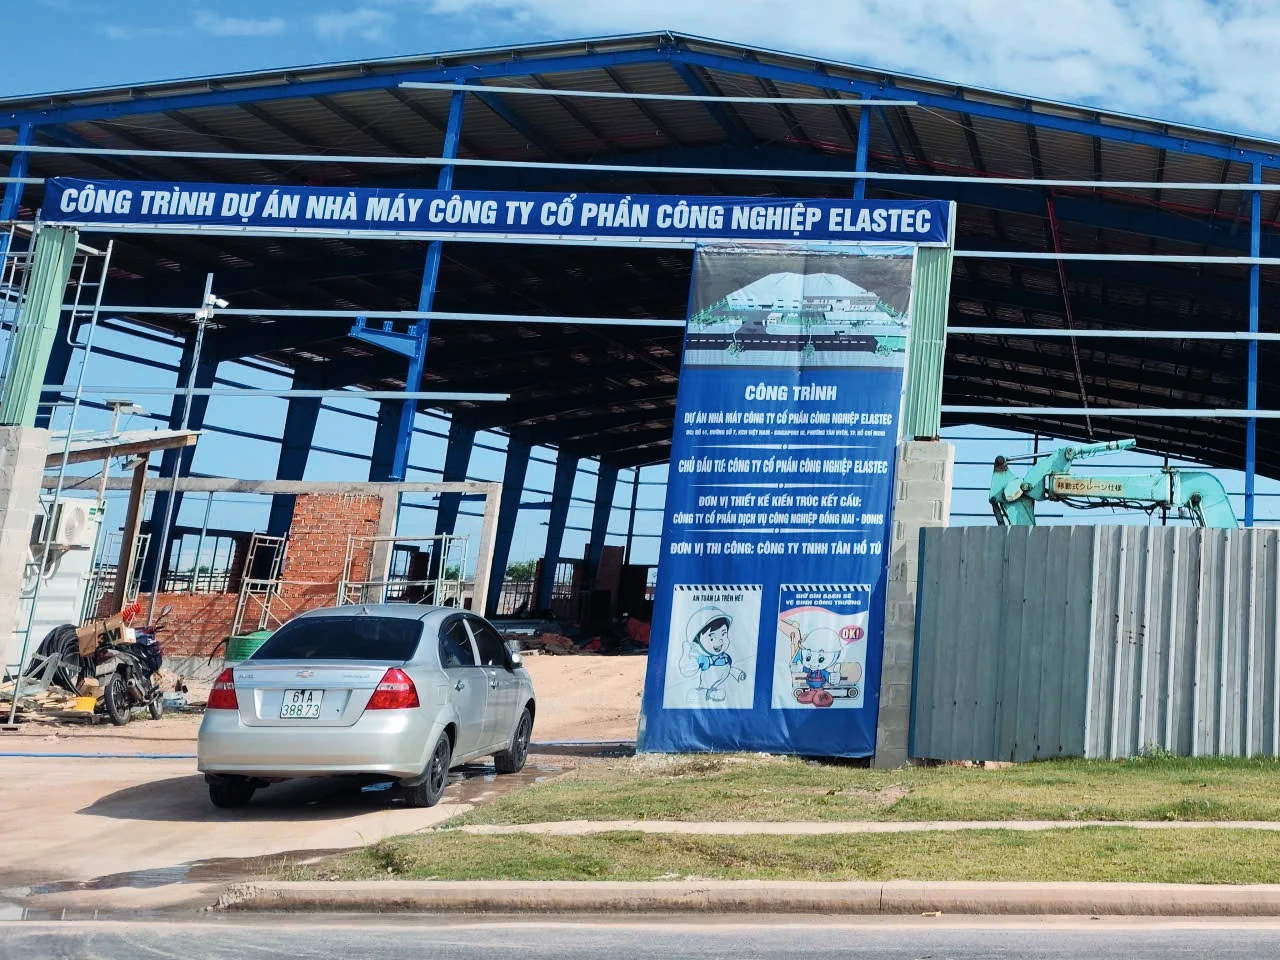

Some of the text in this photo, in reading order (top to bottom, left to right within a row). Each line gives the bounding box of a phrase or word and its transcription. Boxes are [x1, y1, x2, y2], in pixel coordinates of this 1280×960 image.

[60, 184, 932, 236] CÔNG TRÌNH DỰ ÁN NHÀ MÁY CÔNG TY CỔ PHẦN CÔNG NGHIỆP ELASTEC
[744, 382, 838, 401] CÔNG TRÌNH
[684, 411, 696, 426] DỰ
[696, 410, 707, 424] ÁN
[708, 410, 724, 424] NHÀ
[725, 410, 742, 424] MÁY
[743, 411, 765, 424] CÔNG
[766, 413, 776, 424] TY
[810, 411, 830, 424] CÔNG
[832, 411, 860, 426] NGHIỆP
[861, 413, 893, 425] ELASTEC
[678, 456, 695, 472] CHỦ
[696, 456, 712, 472] ĐẦU
[714, 458, 726, 472] TƯ:
[727, 457, 750, 472] CÔNG
[752, 460, 761, 472] TY
[800, 457, 821, 472] CÔNG
[823, 457, 852, 476] NGHIỆP
[854, 460, 888, 473] ELASTEC
[1057, 481, 1122, 491] 移動式クレーン仕様
[698, 493, 861, 508] ĐƠN VỊ THIẾT KẾ KIẾN TRÚC KẾT CẤU:
[673, 512, 693, 524] CÔNG
[696, 513, 704, 524] TY
[738, 513, 756, 526] DỊCH
[758, 513, 767, 526] VỤ
[769, 512, 789, 524] CÔNG
[790, 512, 817, 526] NGHIỆP
[841, 513, 855, 524] NAI
[861, 513, 883, 525] DONIS
[670, 541, 692, 554] ĐƠN
[695, 542, 703, 556] VỊ
[706, 542, 721, 554] THI
[724, 541, 754, 554] CÔNG:
[757, 541, 784, 554] CÔNG
[788, 542, 799, 554] TY
[802, 542, 828, 554] TNHH
[831, 541, 850, 554] TÂN
[842, 627, 860, 639] OK!
[292, 691, 313, 703] 61A
